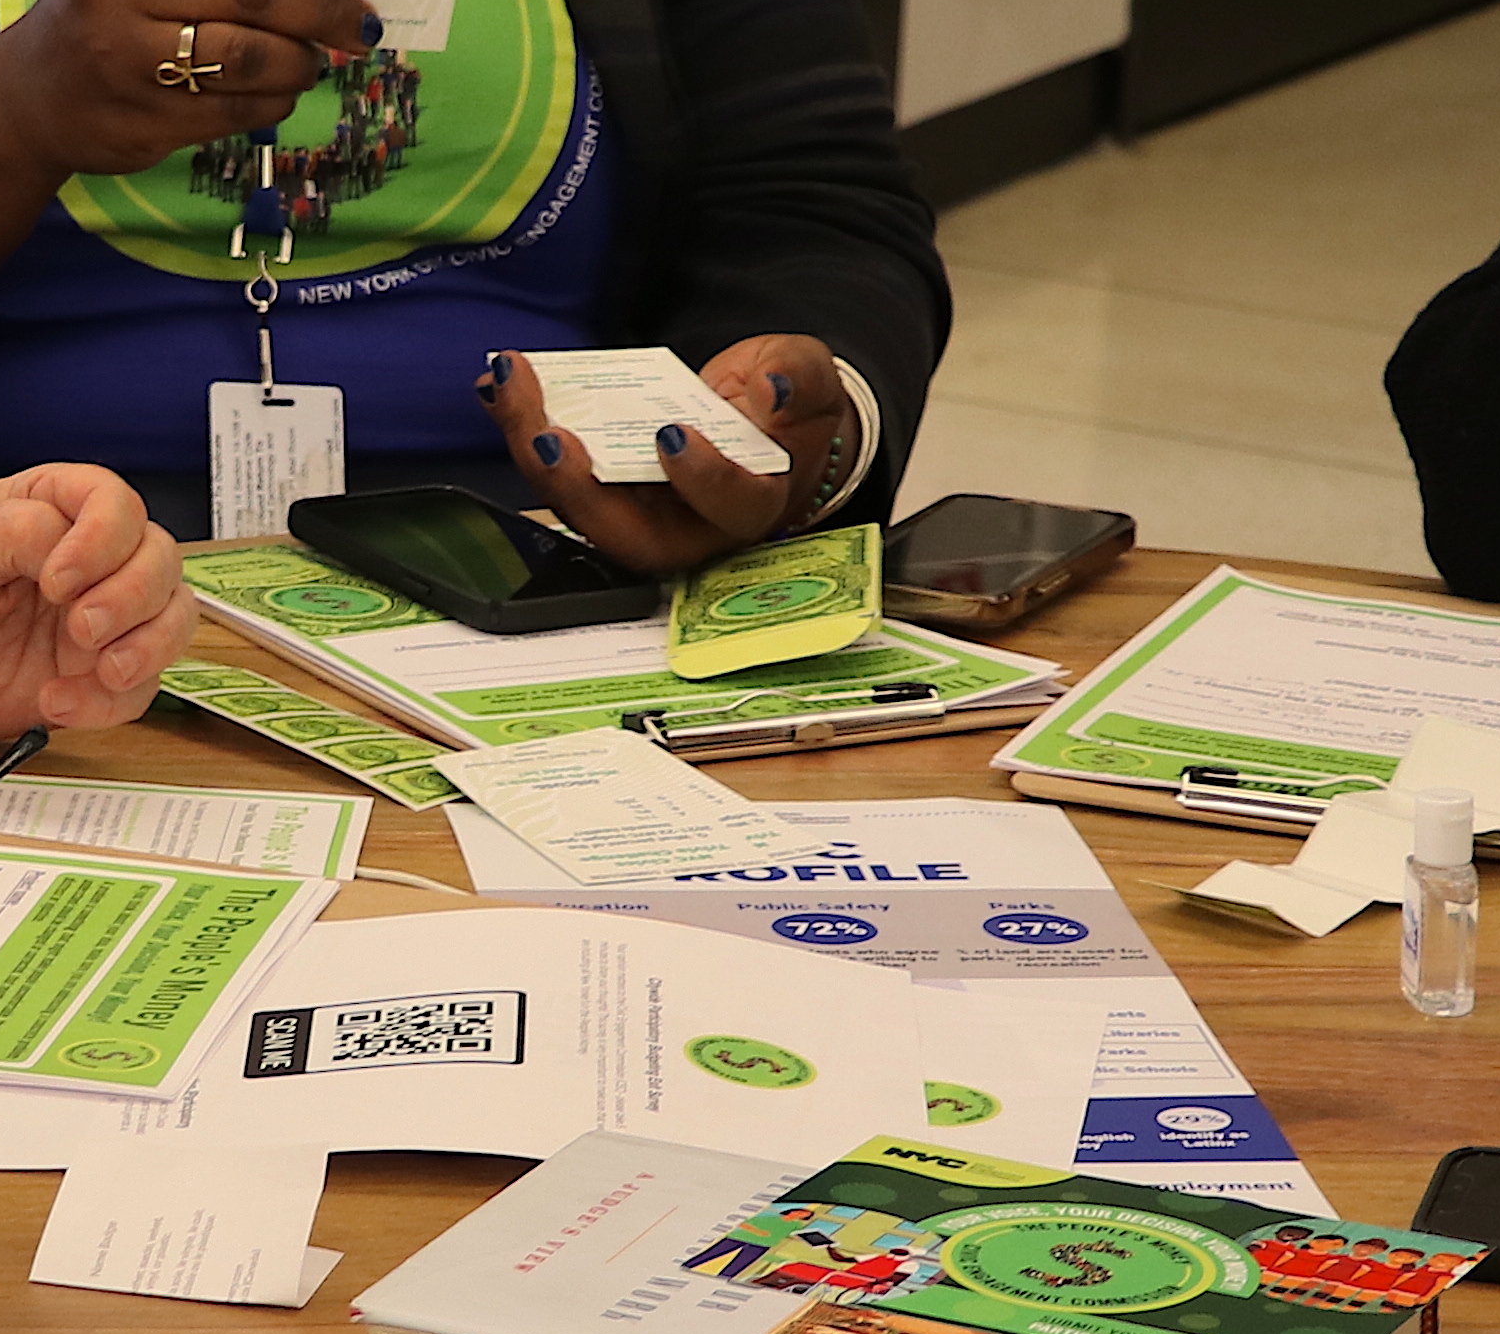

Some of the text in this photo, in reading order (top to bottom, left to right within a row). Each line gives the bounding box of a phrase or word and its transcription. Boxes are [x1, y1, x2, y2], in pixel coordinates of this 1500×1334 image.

[299, 282, 352, 305] NEW
[514, 116, 601, 247] ENGAGEMENT
[218, 888, 279, 913] The
[736, 902, 890, 913] Public Safety
[989, 902, 1054, 910] Parks
[785, 922, 866, 936] 72%
[998, 921, 1080, 936] 27%
[179, 912, 257, 977] People's
[122, 979, 211, 1031] Money
[259, 1017, 298, 1071] SCAN ME
[1159, 1131, 1250, 1141] Identify as
[882, 1146, 968, 1169] NYC
[514, 1171, 656, 1273] A JUDGE'S VIEW
[1053, 1206, 1115, 1220] YOUR
[1061, 1222, 1151, 1242] PEOPLE'S
[600, 1276, 690, 1321] WORK
